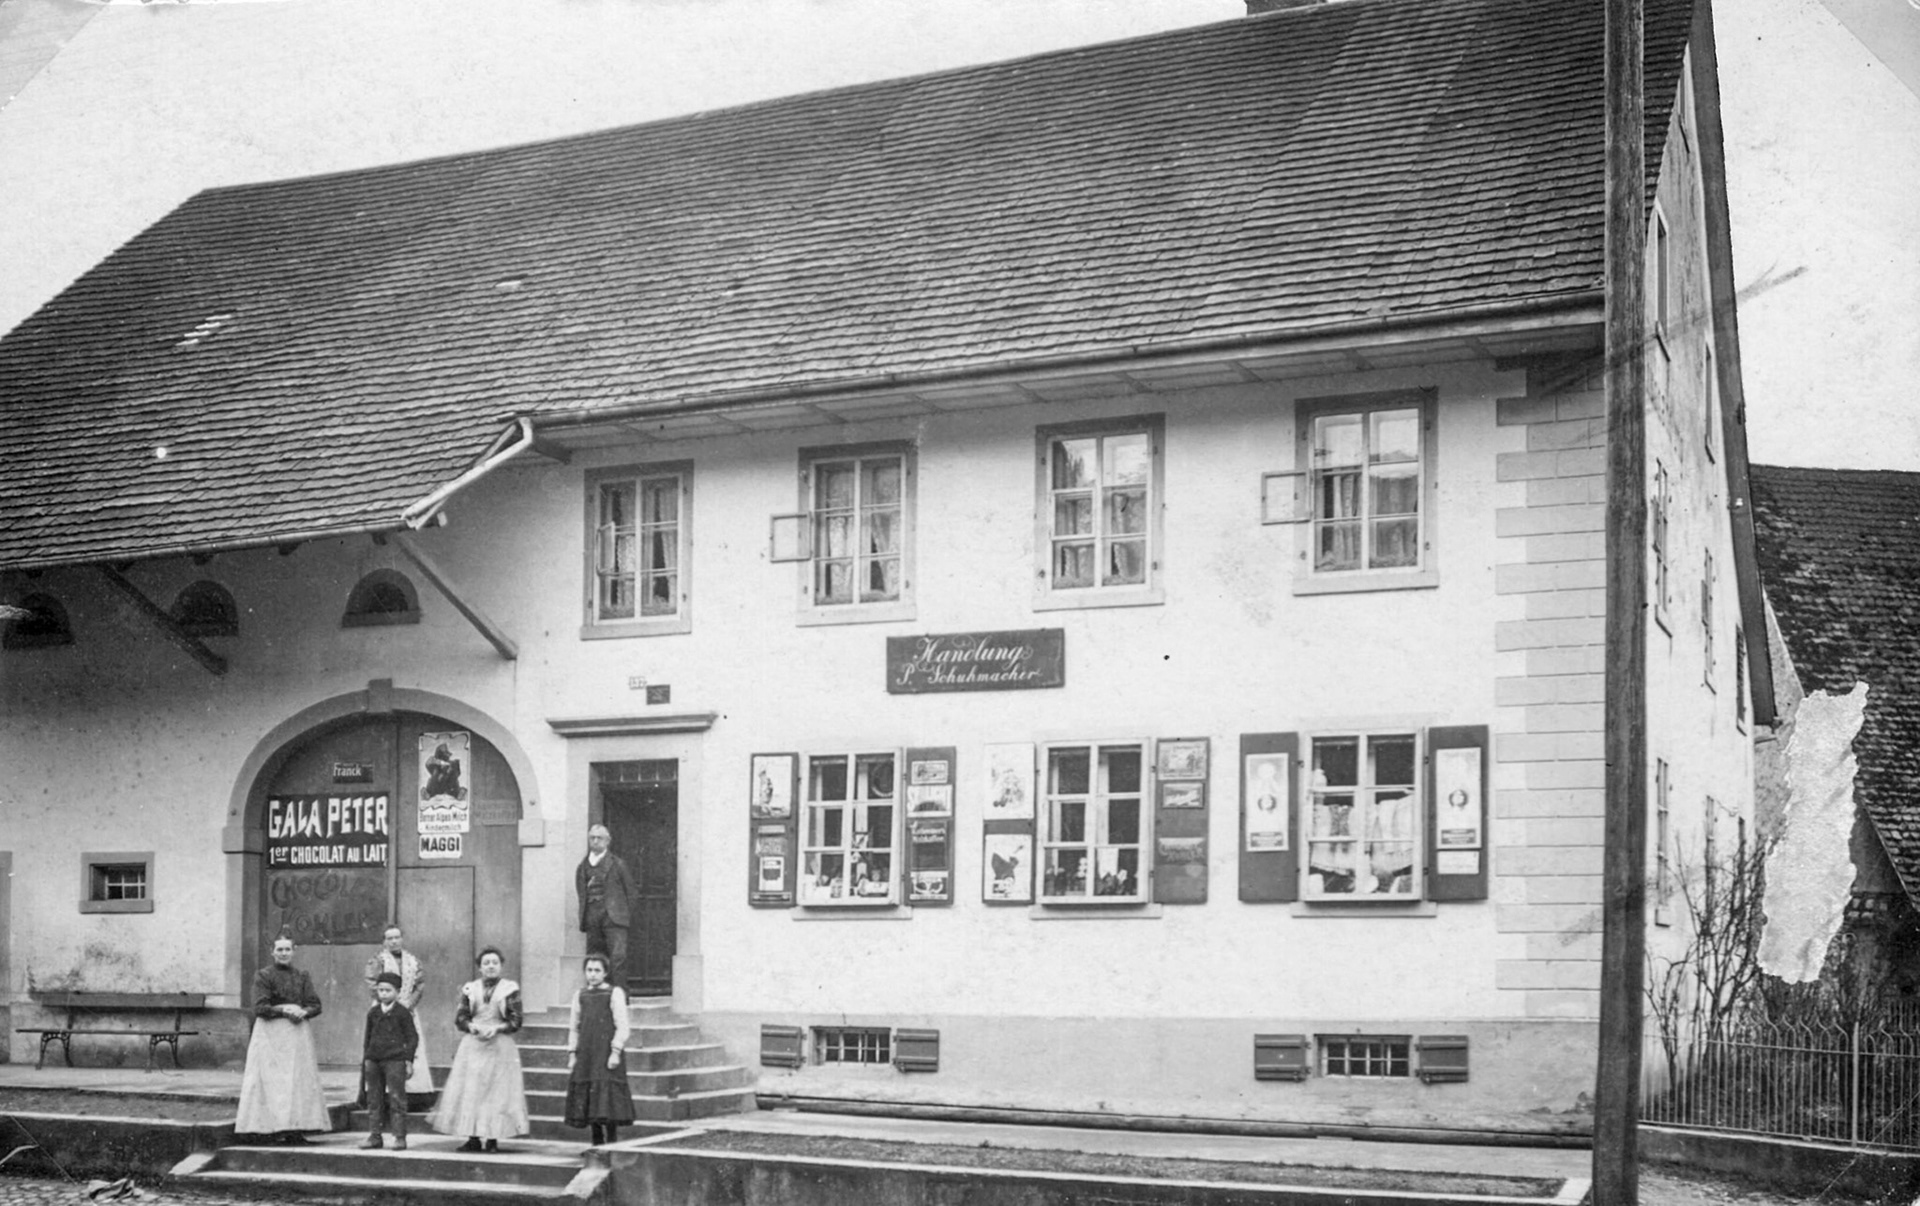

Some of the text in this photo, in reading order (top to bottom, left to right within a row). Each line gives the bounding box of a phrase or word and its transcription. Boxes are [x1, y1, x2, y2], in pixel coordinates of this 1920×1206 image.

[914, 635, 1032, 670] Handlung
[928, 664, 1042, 684] Schuhmacher
[333, 762, 362, 777] Franck
[268, 795, 388, 838] GALA PETER
[420, 836, 460, 853] MAGGI
[269, 846, 288, 864] 1er
[291, 845, 345, 864] CHOCOLAT
[347, 847, 360, 863] AU
